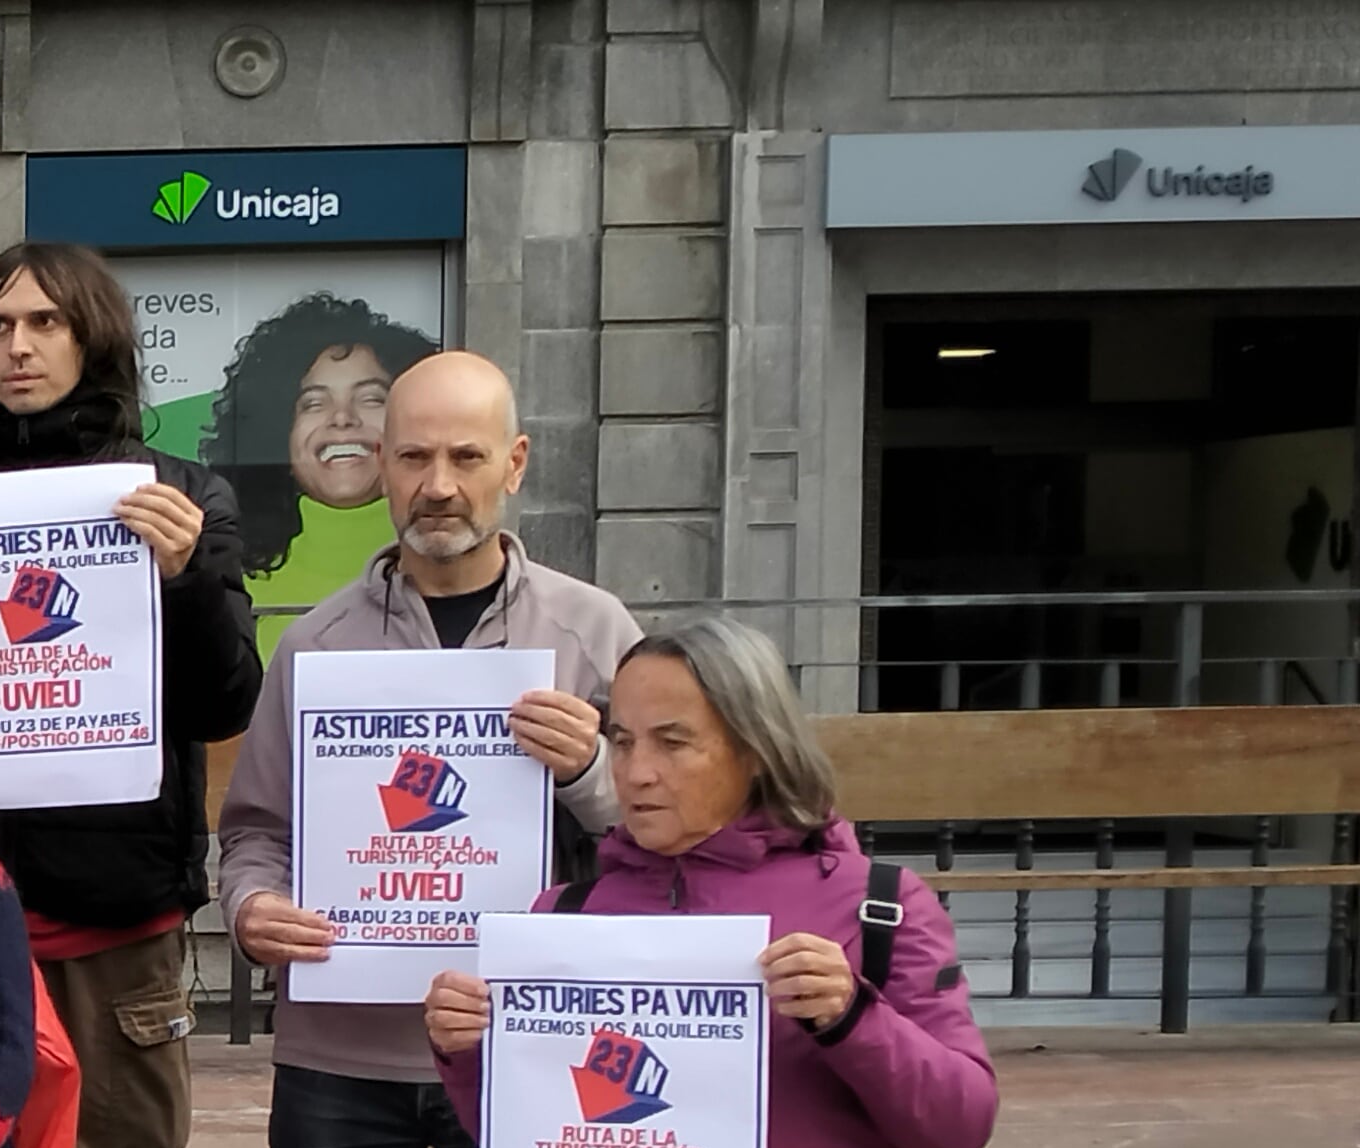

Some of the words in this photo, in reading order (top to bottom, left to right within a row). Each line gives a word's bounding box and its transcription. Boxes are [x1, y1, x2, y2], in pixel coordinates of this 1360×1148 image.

[1147, 165, 1274, 202] Unicaja
[216, 187, 339, 225] Unicaja
[134, 293, 220, 316] reves,
[47, 527, 78, 551] PA
[15, 718, 35, 733] 23
[40, 716, 61, 731] DE
[66, 711, 141, 729] PAYARES
[312, 714, 429, 738] ASTURIES
[435, 714, 468, 737] PA
[474, 713, 510, 738] VIV
[370, 835, 418, 849] RUTA
[422, 835, 446, 849] DE
[450, 836, 473, 850] LA
[501, 984, 622, 1016] ASTURIES
[631, 988, 670, 1015] PA
[675, 989, 747, 1016] VIVIR
